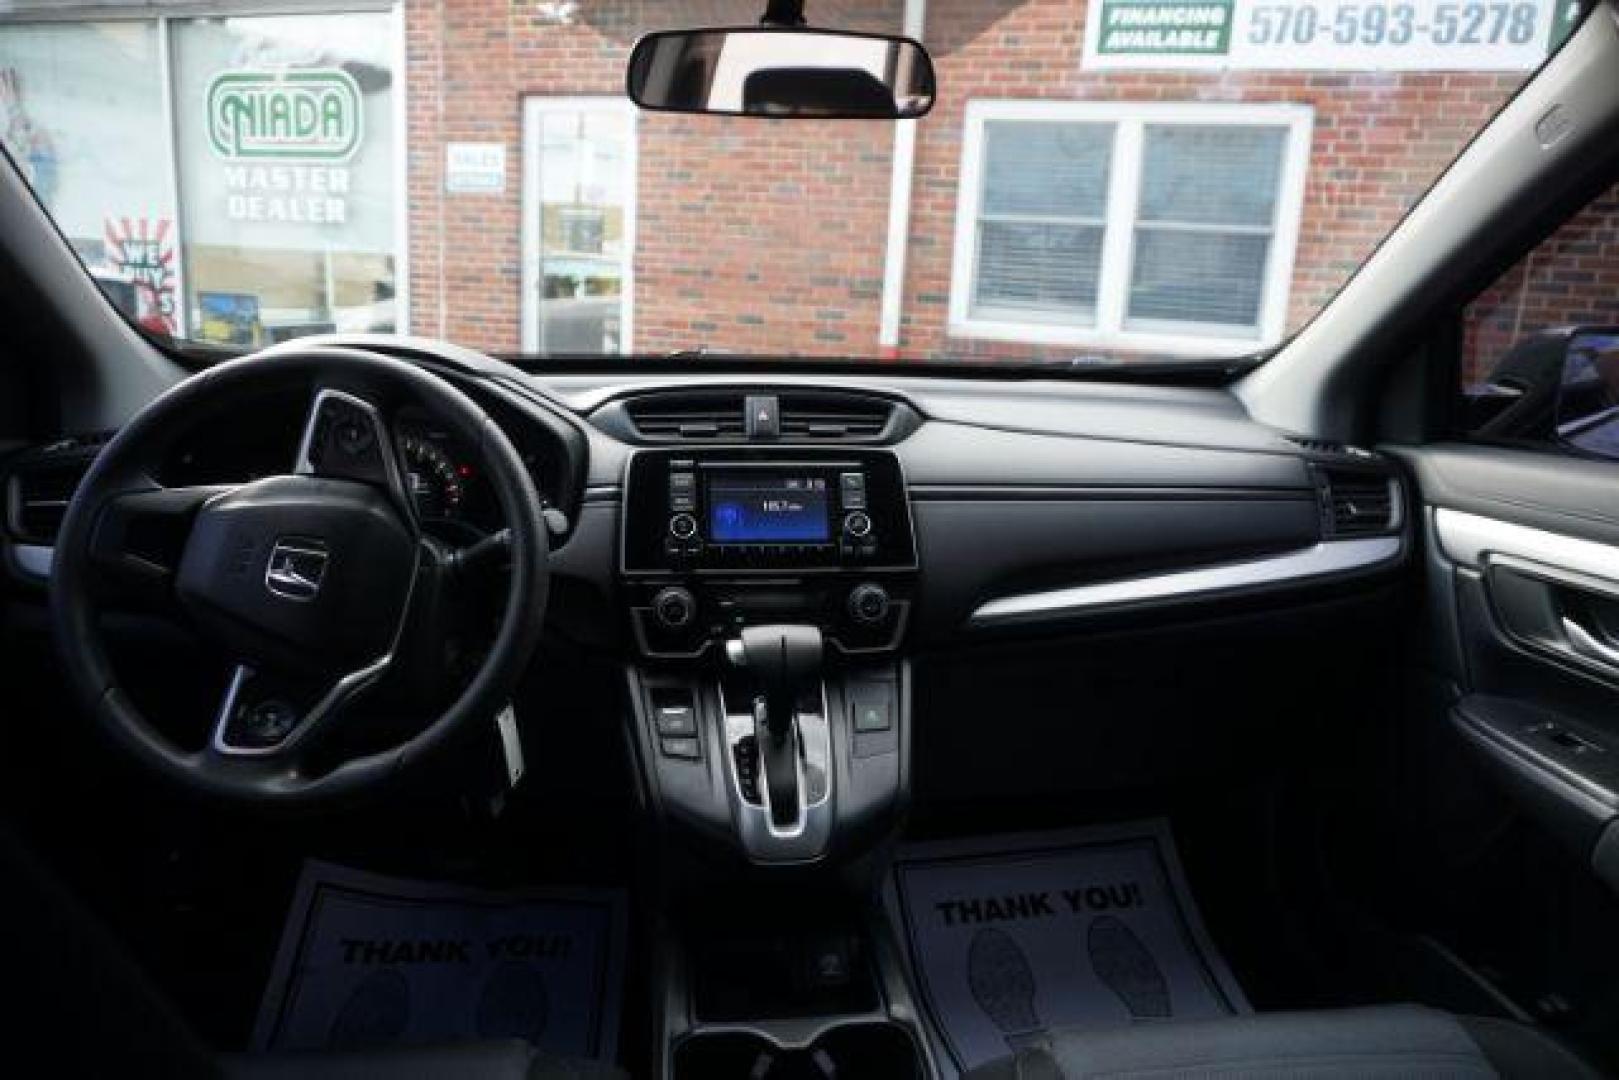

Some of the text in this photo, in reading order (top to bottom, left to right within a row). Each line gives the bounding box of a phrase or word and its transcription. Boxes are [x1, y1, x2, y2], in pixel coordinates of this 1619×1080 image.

[1109, 6, 1225, 26] FINANCING
[1247, 2, 1538, 45] 570-593-5278
[1106, 29, 1220, 49] AVAILABLE
[219, 92, 343, 143] NIADA
[224, 166, 350, 193] MASTER
[228, 194, 346, 224] DEALER
[936, 881, 1145, 928] THANK YOU!
[340, 936, 473, 965] THANK
